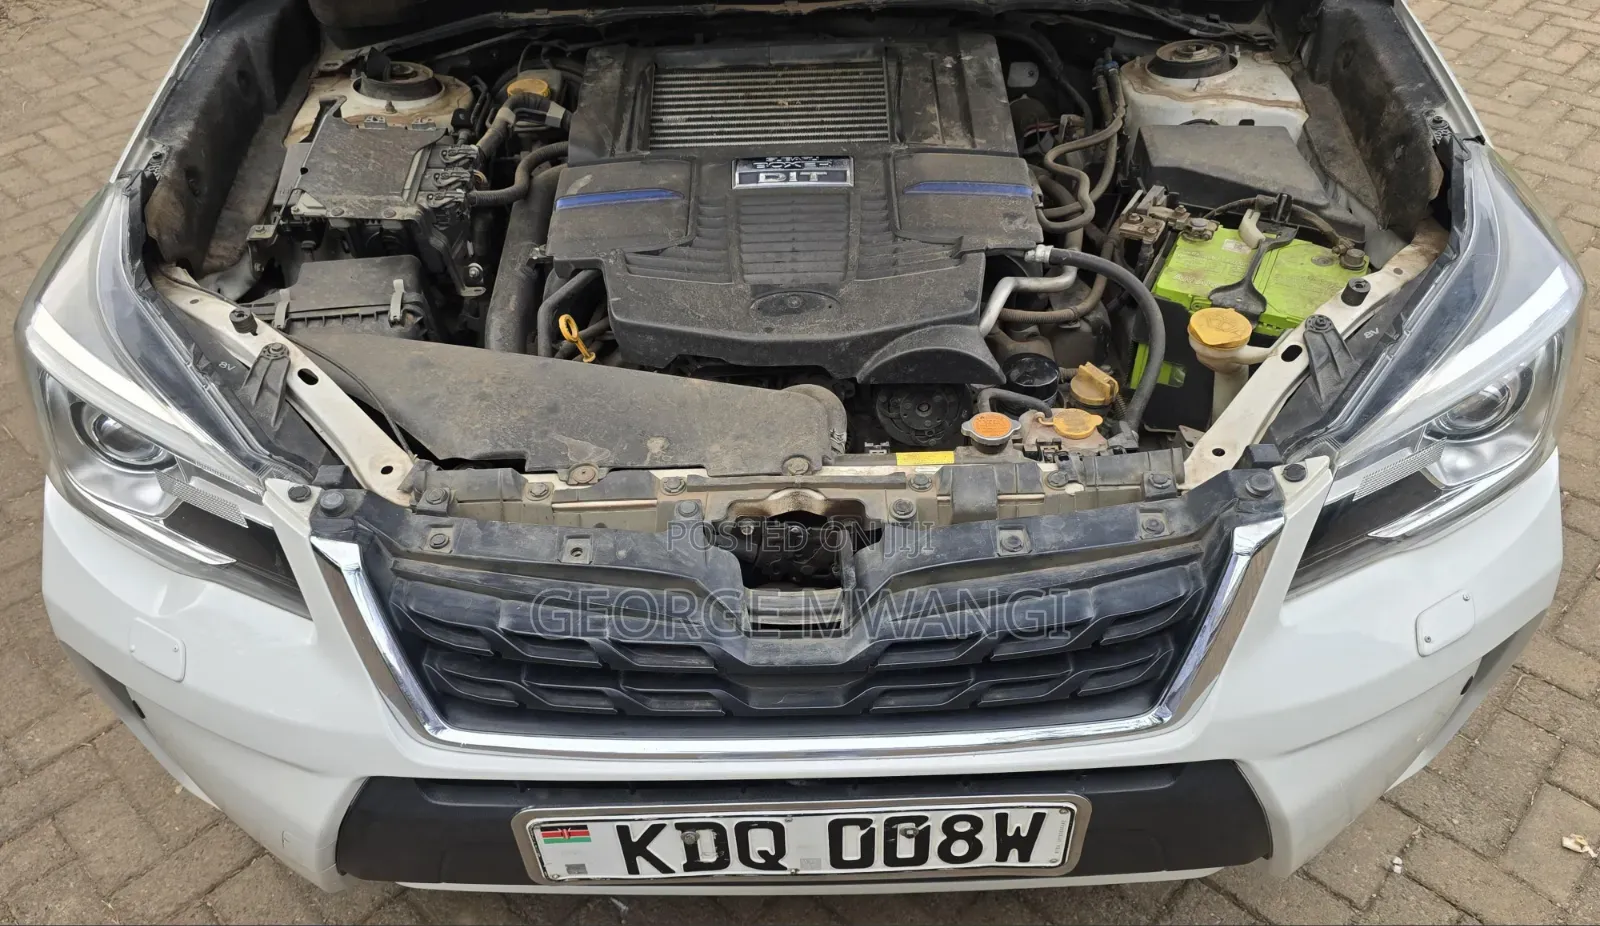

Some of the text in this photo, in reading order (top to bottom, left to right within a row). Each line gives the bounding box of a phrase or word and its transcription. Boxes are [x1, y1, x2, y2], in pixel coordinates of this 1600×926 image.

[758, 171, 828, 182] DIT
[616, 820, 788, 875] KDQ
[827, 811, 1048, 870] 008W
